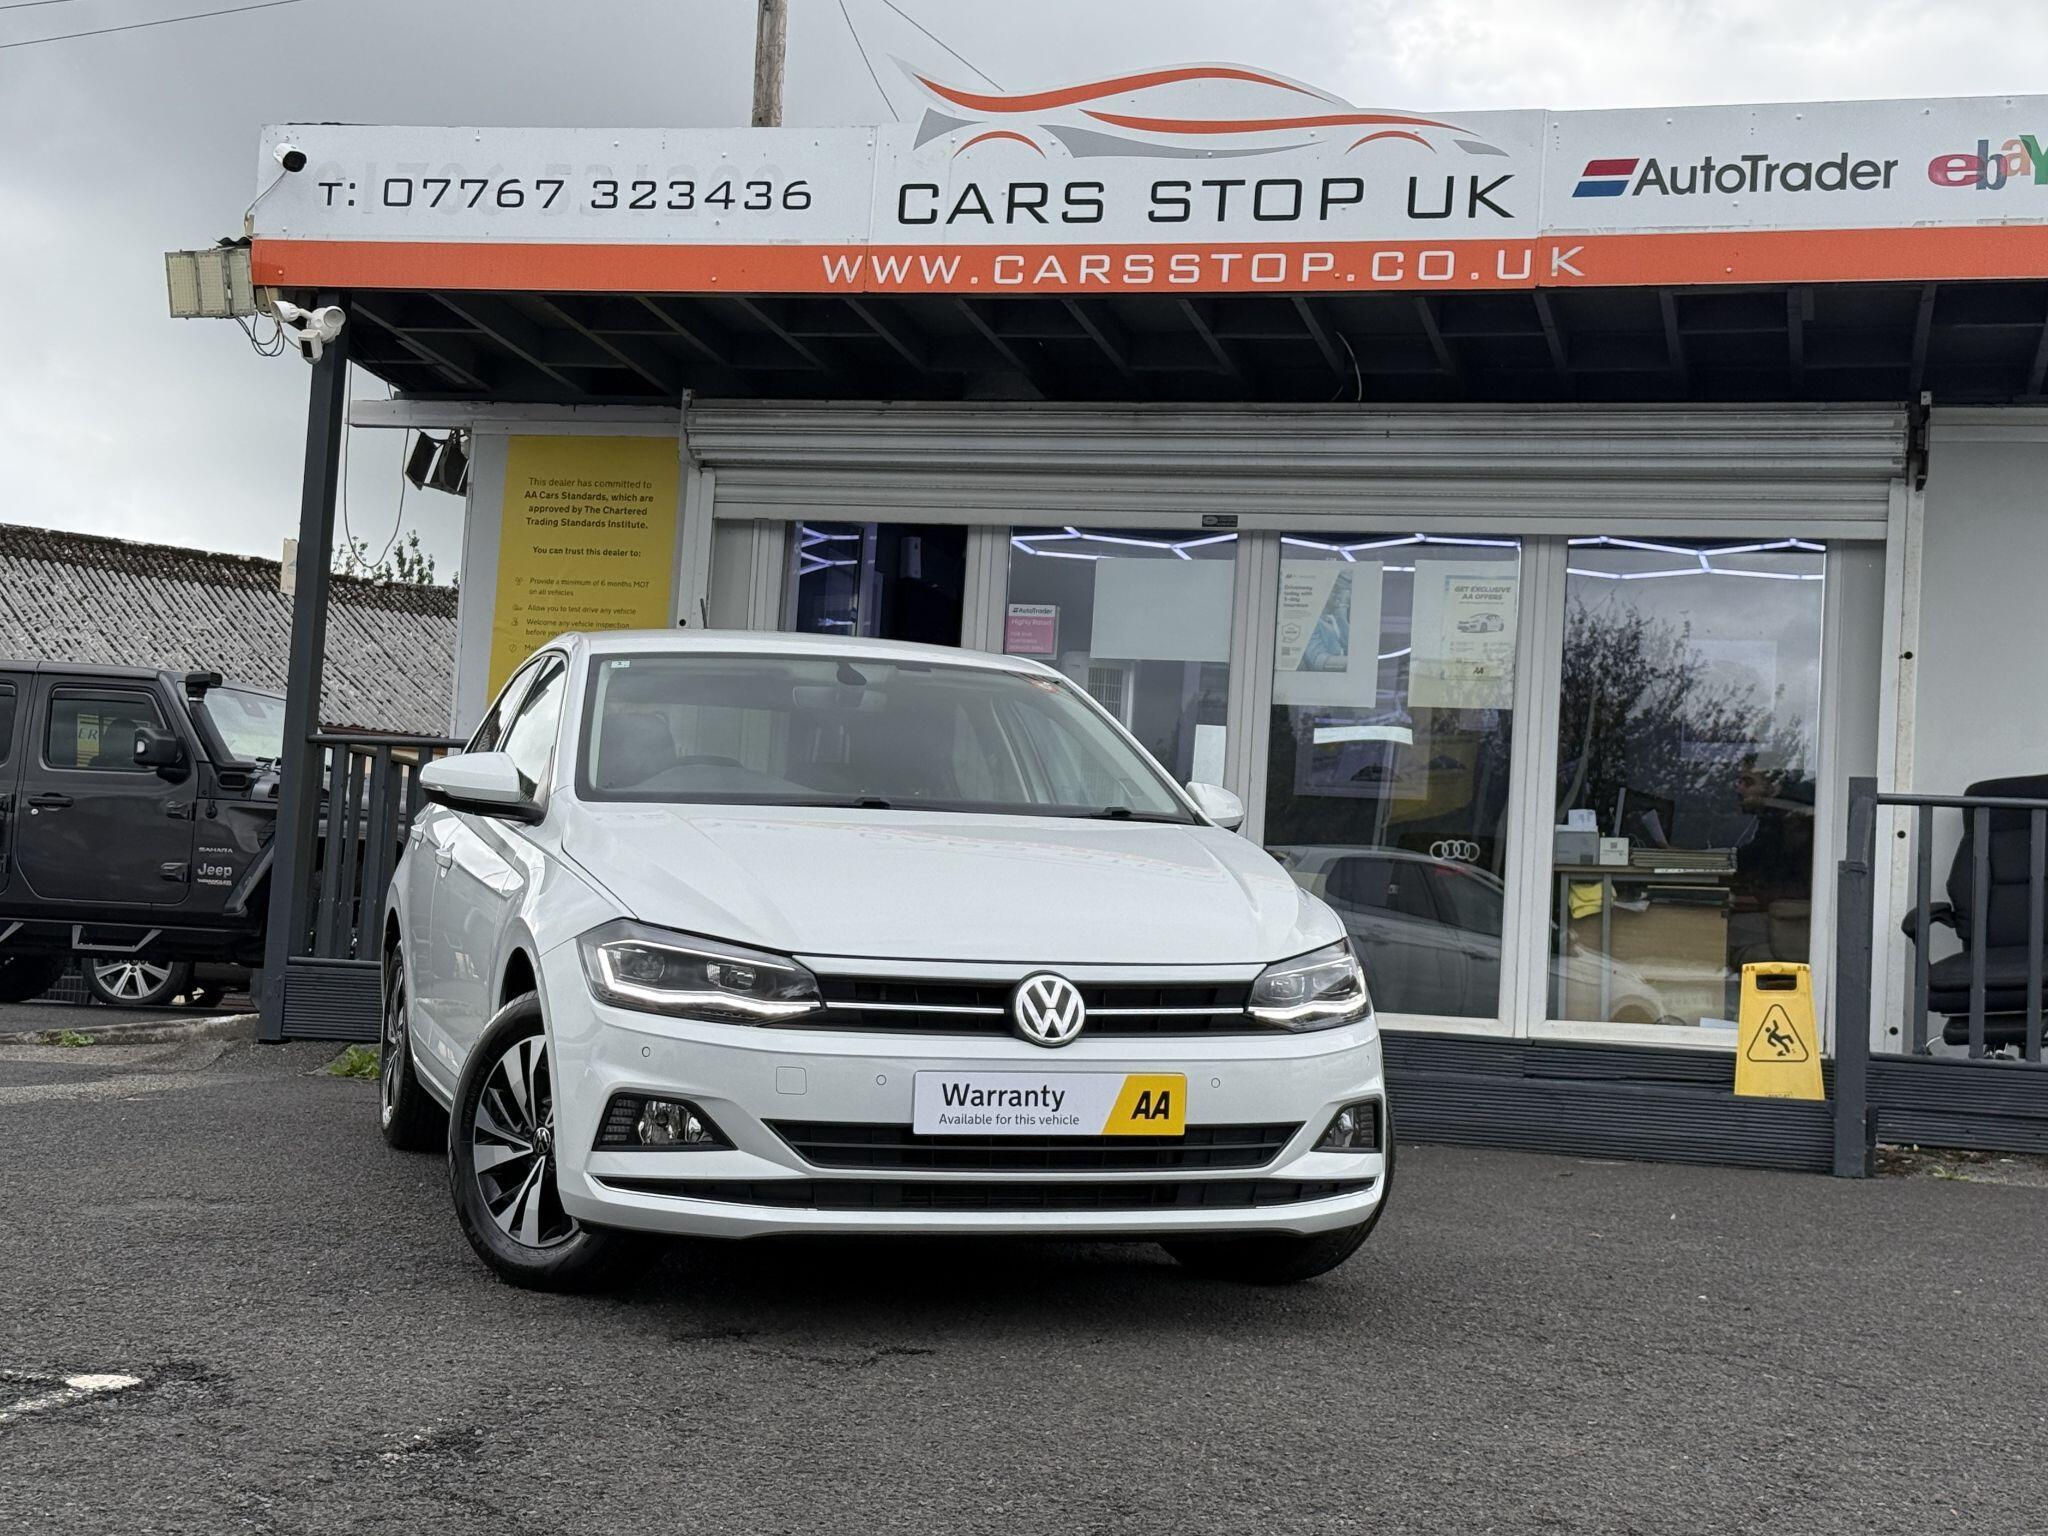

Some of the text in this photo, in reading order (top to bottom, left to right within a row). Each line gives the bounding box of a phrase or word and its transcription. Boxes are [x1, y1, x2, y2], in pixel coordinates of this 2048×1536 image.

[1631, 152, 1899, 197] AutoTrader
[382, 178, 566, 210] 07767
[590, 179, 814, 211] 323436
[897, 174, 1516, 226] CARS STOP UK
[529, 477, 652, 489] This dealer has committed to
[524, 491, 537, 500] AA
[539, 491, 559, 501] Cars
[611, 493, 638, 502] which
[639, 495, 654, 503] are
[528, 505, 648, 516] approved by The Chartered
[526, 517, 559, 528] Trading
[560, 518, 606, 528] Standards
[532, 546, 548, 554] You
[549, 547, 563, 555] can
[565, 547, 584, 556] trust
[586, 547, 601, 556] this
[602, 548, 629, 558] dealer
[529, 577, 556, 586] Provide
[1454, 585, 1470, 593] GET
[196, 862, 233, 879] Jeep
[941, 1082, 1066, 1113] Warranty
[1130, 1090, 1171, 1120] AA
[939, 1113, 1080, 1126] Available for this vehicle
